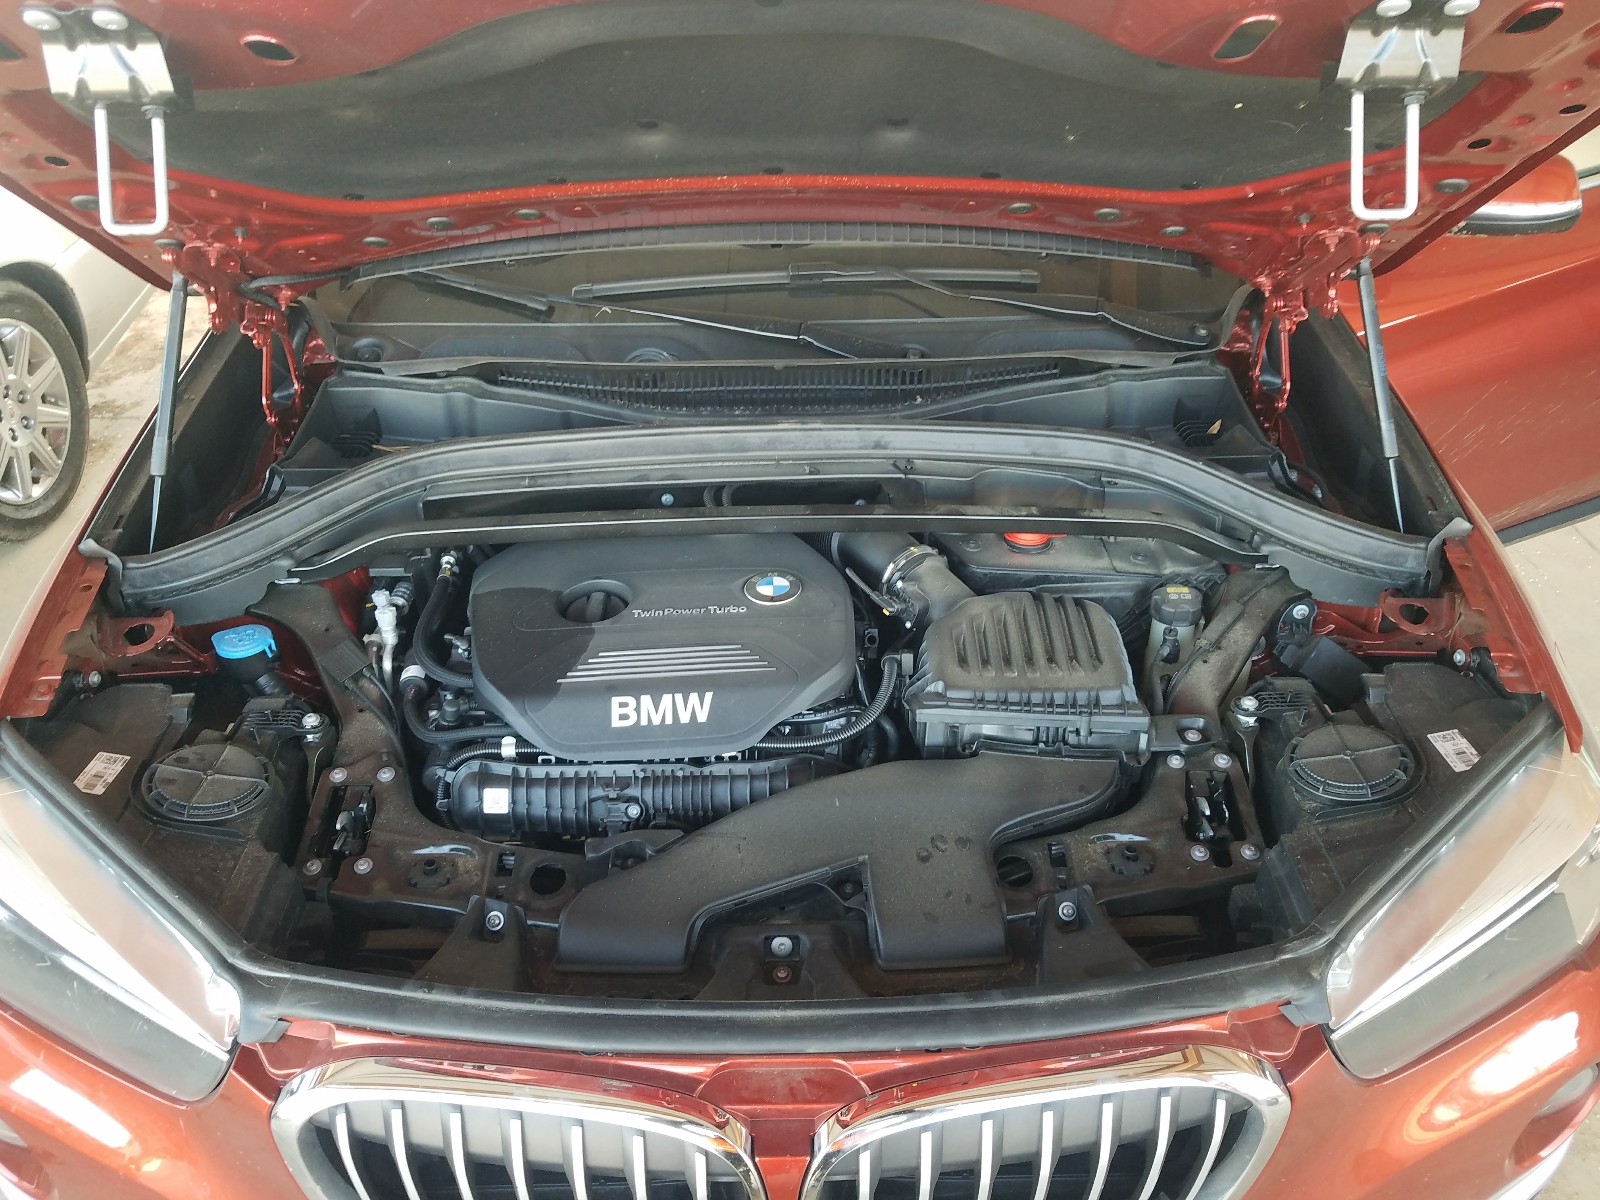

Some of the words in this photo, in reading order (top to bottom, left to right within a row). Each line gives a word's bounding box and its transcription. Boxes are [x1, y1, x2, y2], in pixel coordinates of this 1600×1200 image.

[751, 572, 796, 583] BMW
[632, 607, 706, 618] TwinPower
[707, 604, 747, 614] Turbo
[611, 691, 714, 728] BMW
